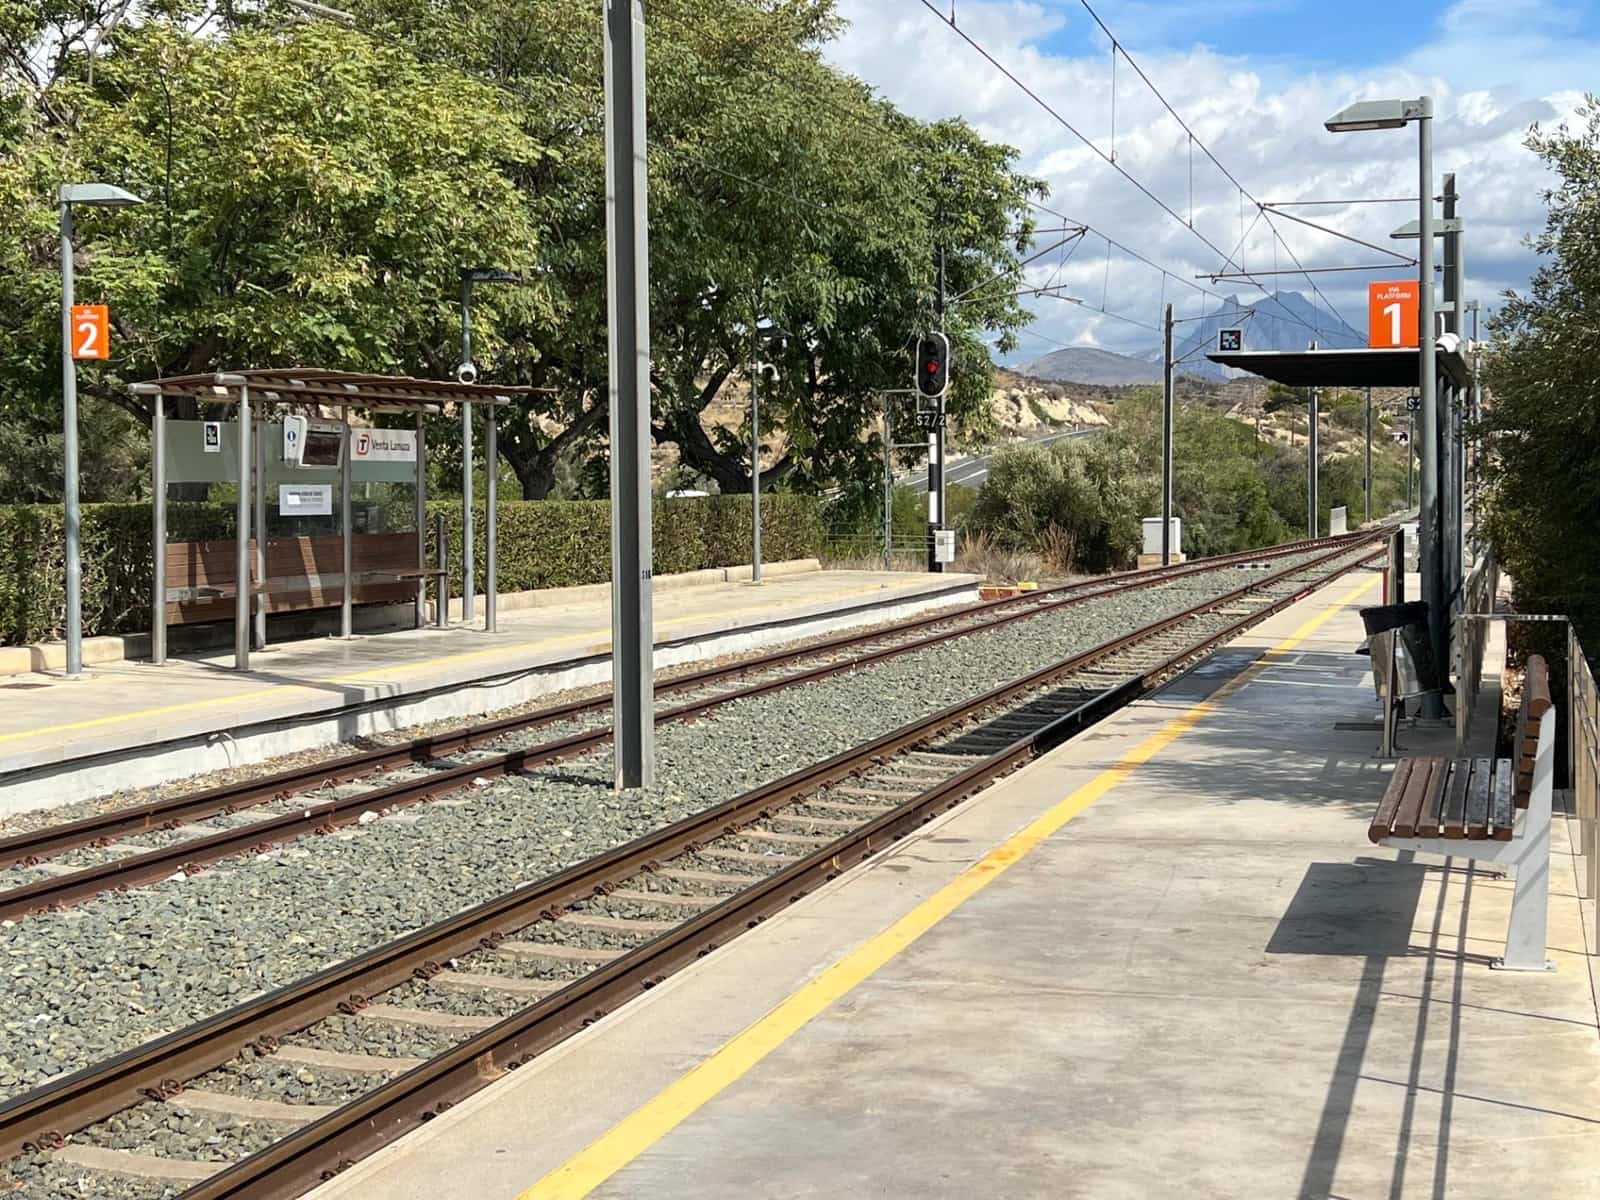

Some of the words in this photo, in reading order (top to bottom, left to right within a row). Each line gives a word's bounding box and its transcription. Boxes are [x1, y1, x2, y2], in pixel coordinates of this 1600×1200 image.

[78, 321, 98, 356] 2
[1383, 302, 1401, 345] 1
[916, 413, 945, 428] S2/2
